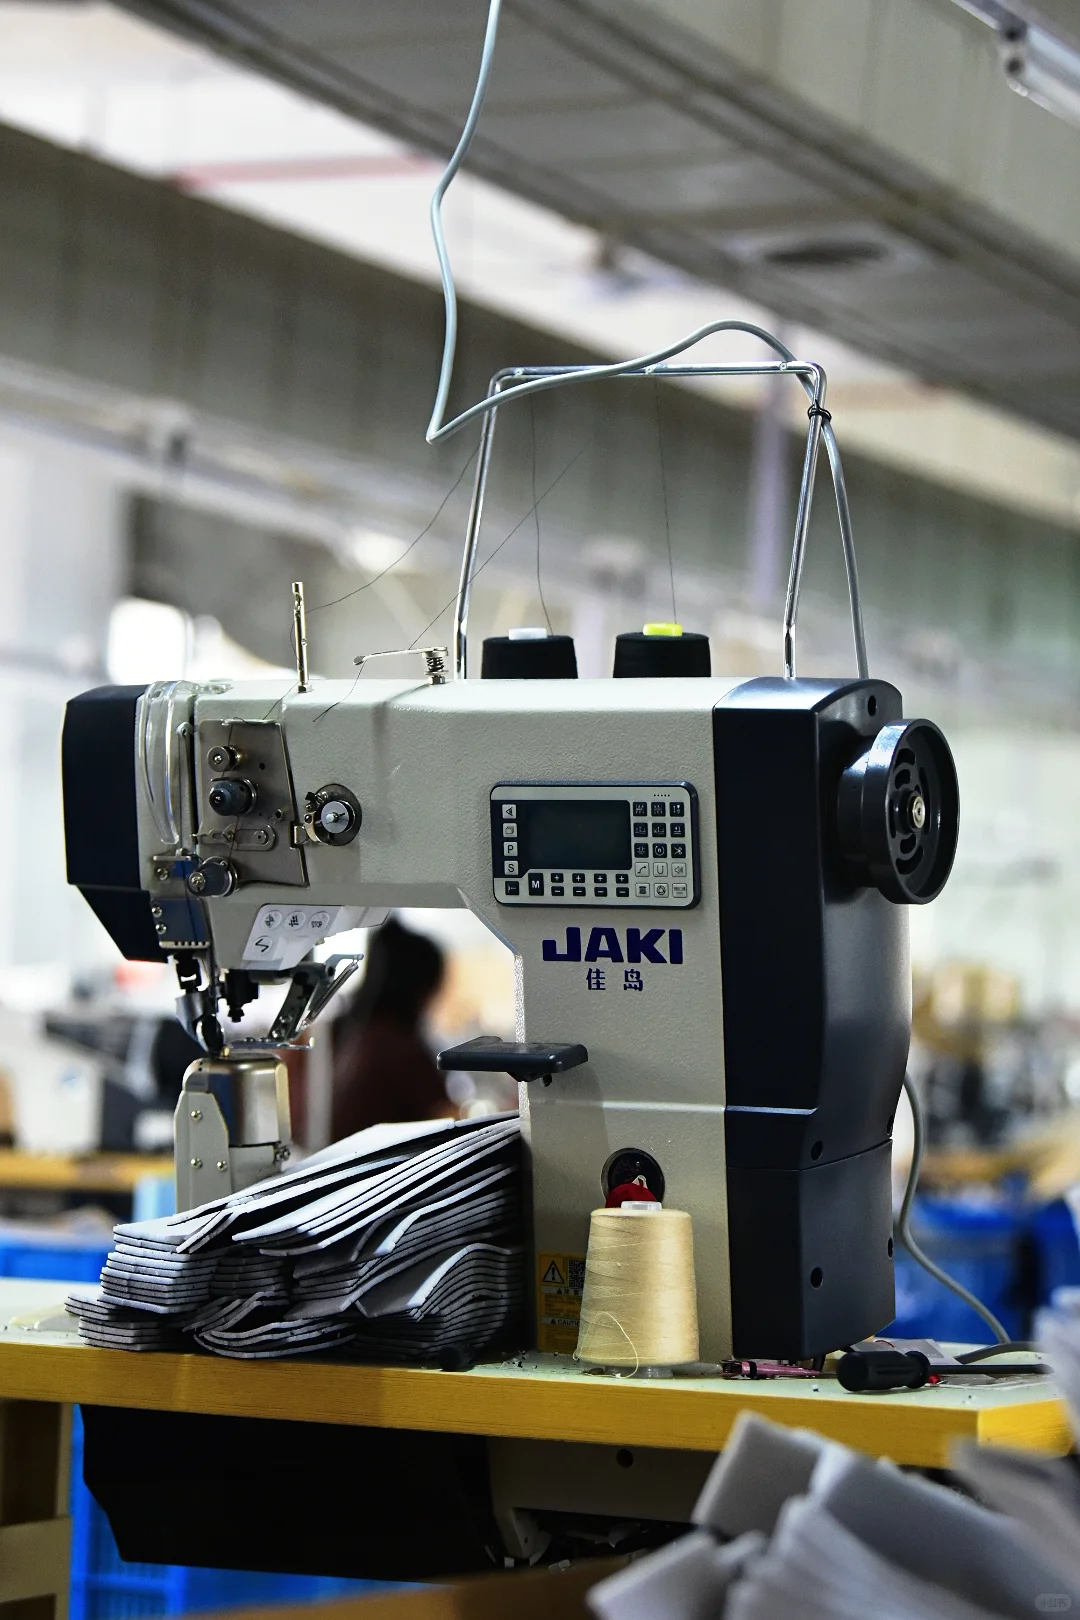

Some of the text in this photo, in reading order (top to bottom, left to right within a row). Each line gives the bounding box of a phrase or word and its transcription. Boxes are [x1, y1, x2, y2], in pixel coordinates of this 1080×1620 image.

[507, 844, 514, 854] P
[507, 863, 515, 873] S
[531, 880, 540, 889] M
[311, 920, 323, 928] STOP
[542, 927, 683, 964] JAKI
[586, 968, 643, 991] 佳岛
